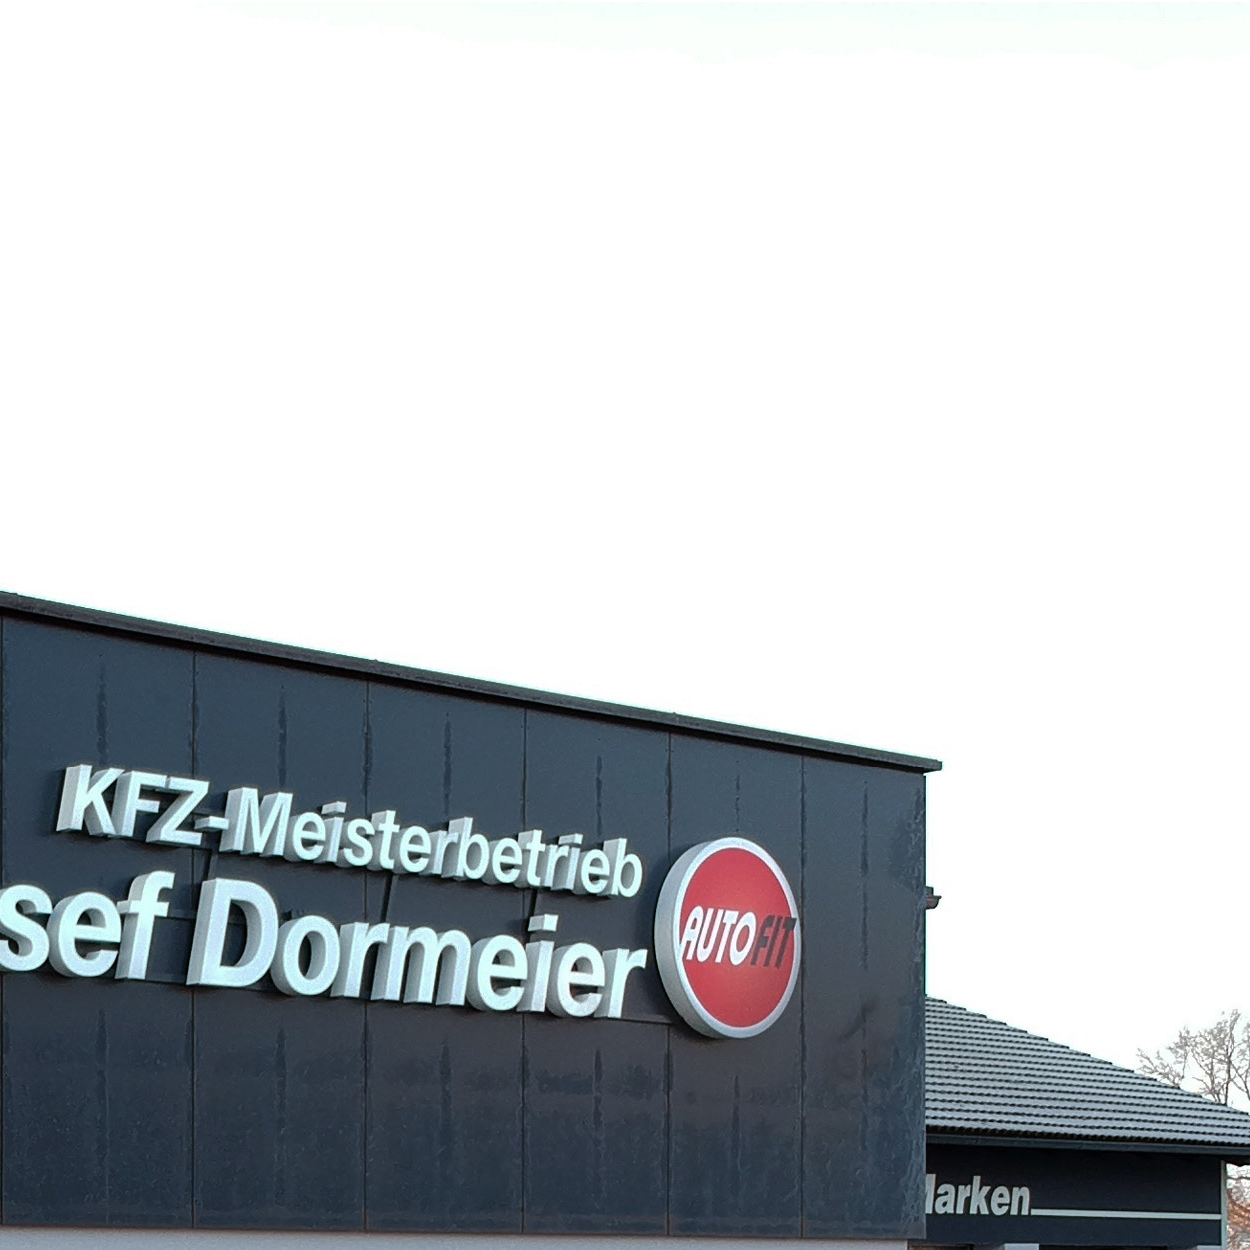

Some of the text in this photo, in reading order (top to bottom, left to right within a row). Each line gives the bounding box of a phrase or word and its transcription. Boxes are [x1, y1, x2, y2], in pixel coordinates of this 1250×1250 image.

[56, 762, 643, 898] KFZ-Meisterbetrieb
[186, 877, 647, 1019] Dormeier
[681, 905, 797, 969] AUTOFIT
